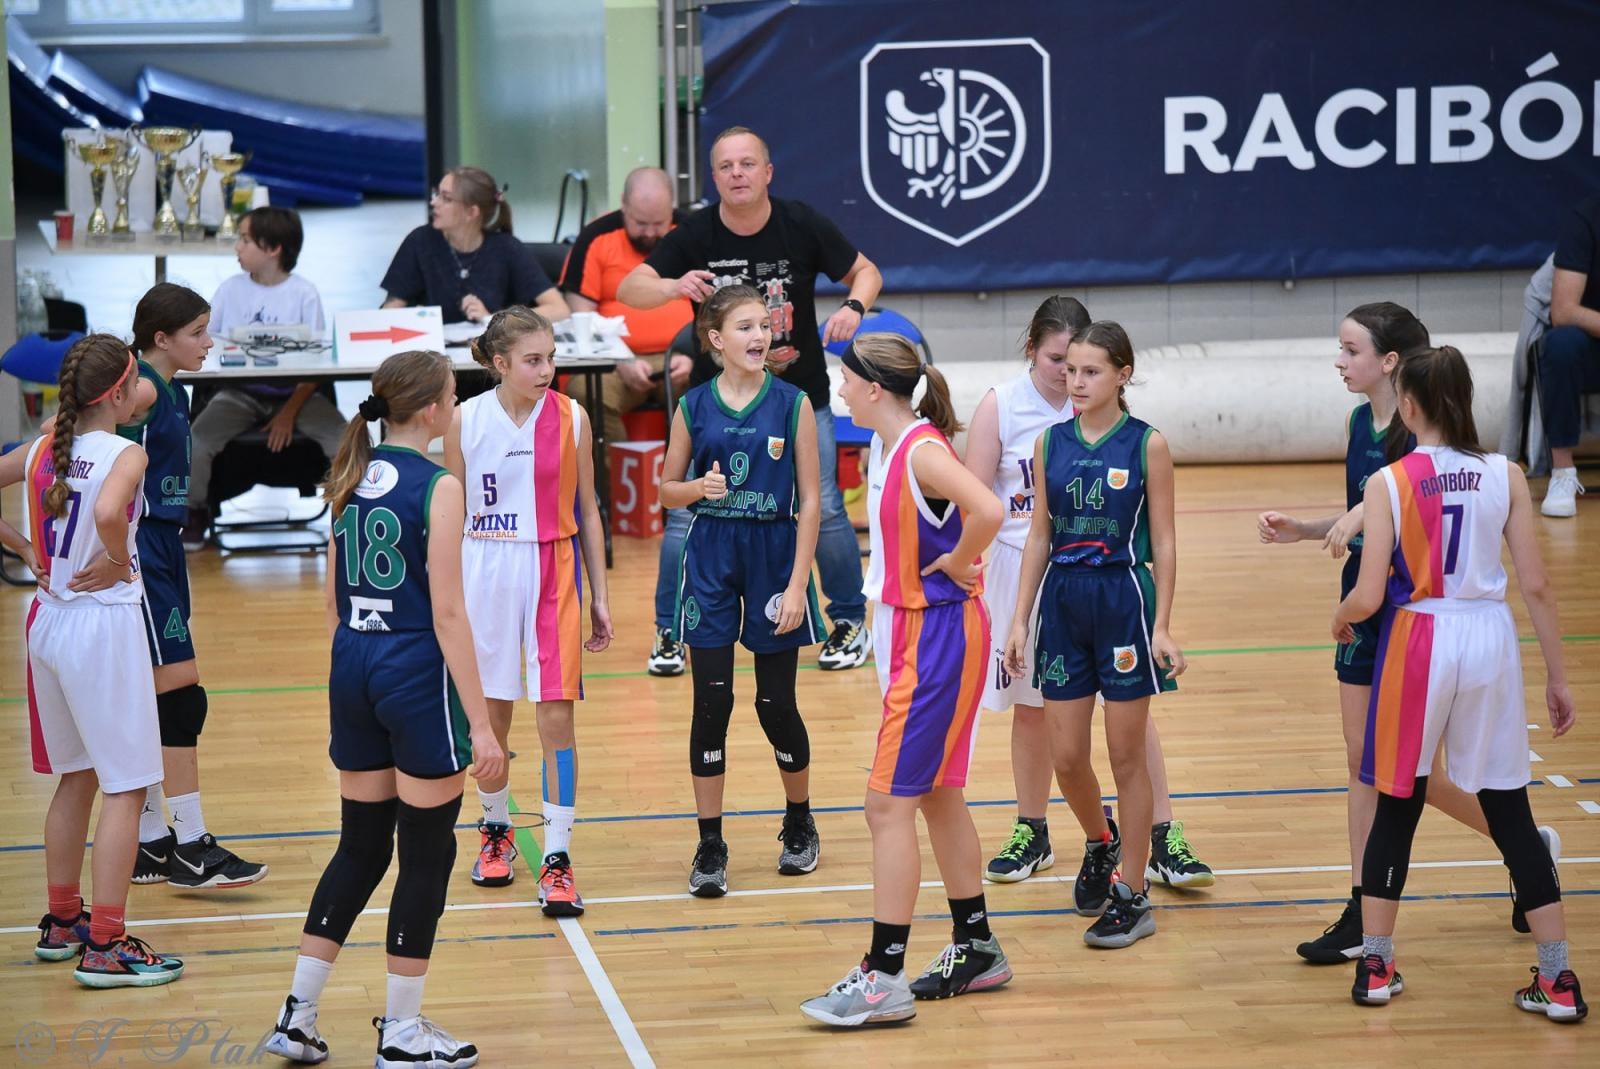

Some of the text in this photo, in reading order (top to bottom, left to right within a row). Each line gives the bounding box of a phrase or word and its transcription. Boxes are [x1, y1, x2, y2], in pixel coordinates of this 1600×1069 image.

[1164, 51, 1600, 175] RACIBÓ
[616, 456, 639, 514] 5
[729, 451, 750, 486] 9
[482, 473, 498, 507] 5
[1065, 477, 1105, 510] 14
[334, 504, 407, 591] 18
[163, 606, 187, 642] 4
[685, 596, 701, 630] 9
[1040, 651, 1069, 687] 14
[710, 749, 722, 763] NBA
